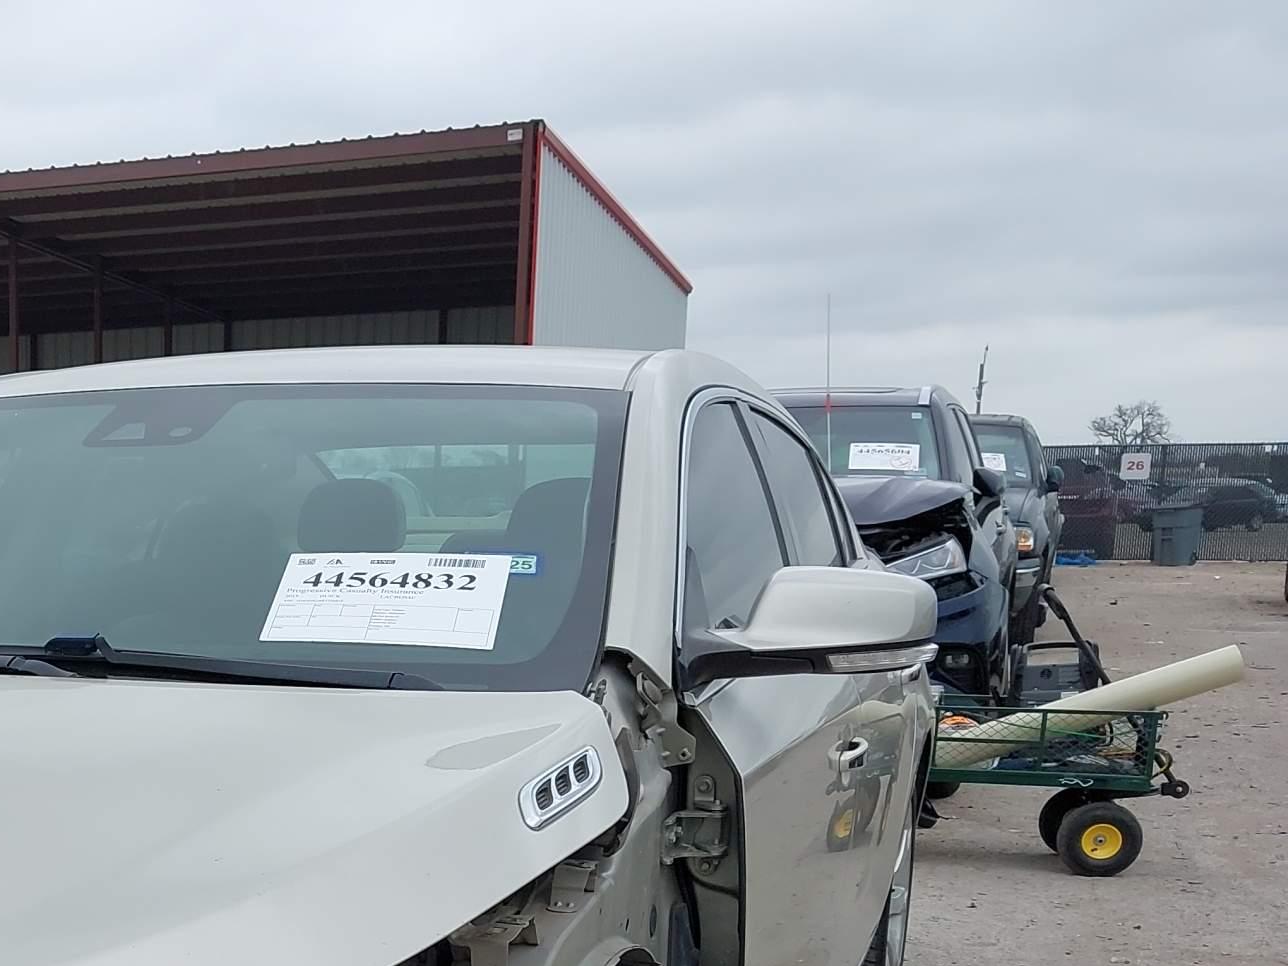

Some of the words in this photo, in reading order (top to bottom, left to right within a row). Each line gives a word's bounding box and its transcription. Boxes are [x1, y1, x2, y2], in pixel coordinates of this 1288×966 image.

[1127, 461, 1145, 471] 26
[510, 560, 533, 570] 25
[303, 571, 477, 591] 44564832
